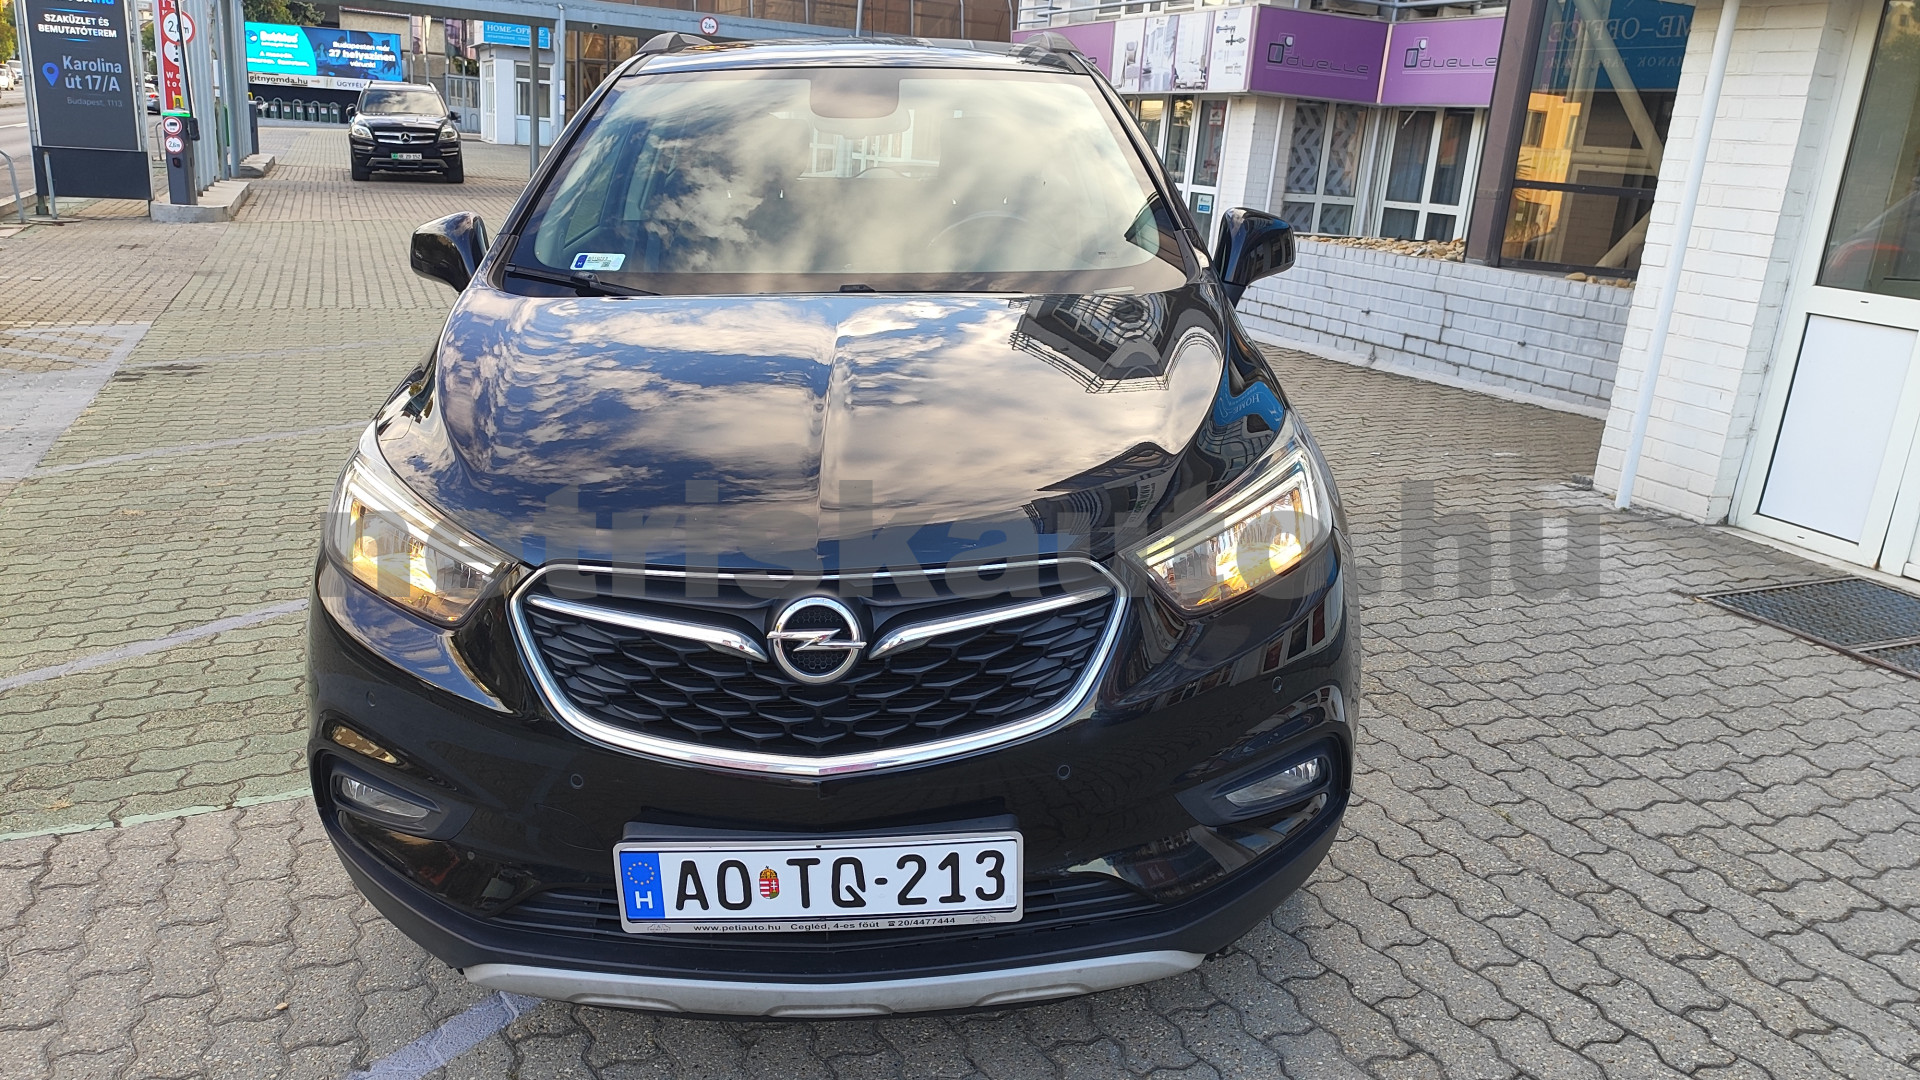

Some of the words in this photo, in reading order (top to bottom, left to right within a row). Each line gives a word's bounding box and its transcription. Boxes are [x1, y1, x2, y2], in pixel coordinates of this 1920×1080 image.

[43, 13, 96, 26] SZAKÜZLET
[98, 16, 109, 27] ÉS
[37, 23, 117, 38] BEMUTATÓTEREM
[487, 24, 545, 37] HOME-OFFE
[328, 49, 341, 58] 27
[62, 55, 122, 74] Karolina
[65, 73, 83, 90] út
[84, 74, 121, 92] 17/A
[107, 99, 123, 108] 1113
[675, 859, 753, 911] AO
[786, 849, 1006, 909] TQ-213
[635, 890, 654, 909] H
[693, 923, 781, 932] www.petiauto.hu
[790, 922, 830, 932] Cegléd,
[897, 917, 956, 927] 20/4477444
